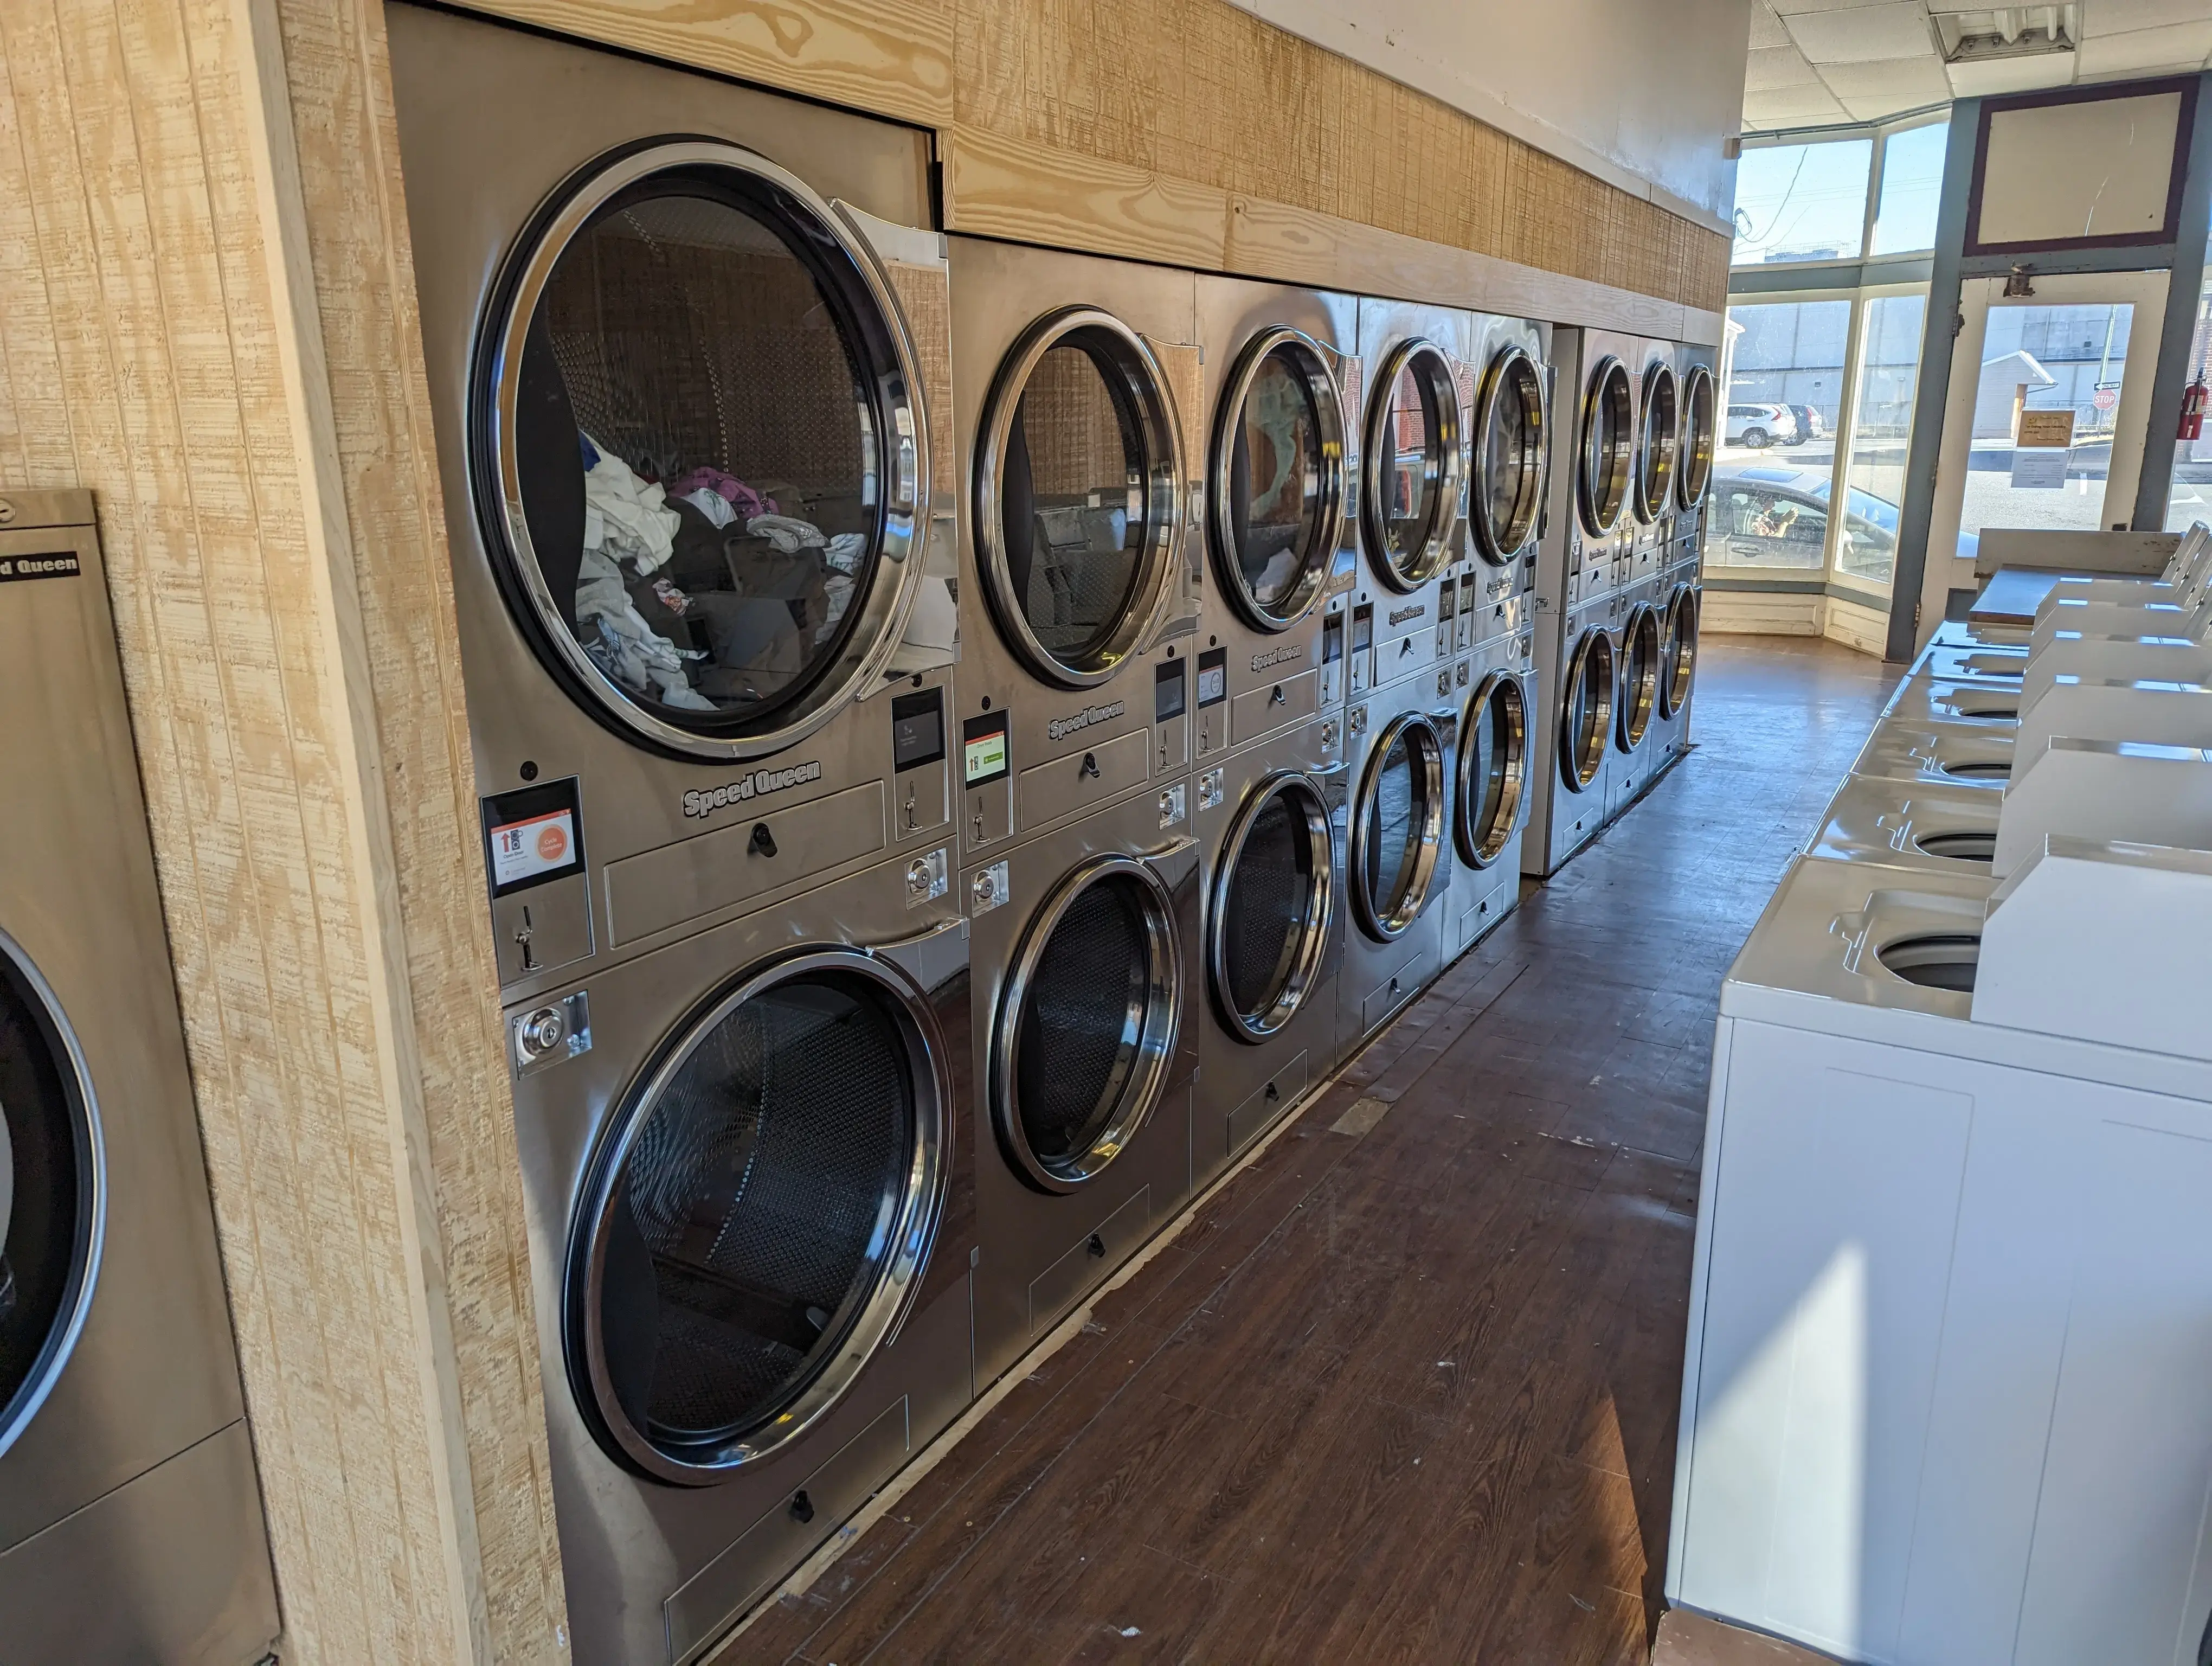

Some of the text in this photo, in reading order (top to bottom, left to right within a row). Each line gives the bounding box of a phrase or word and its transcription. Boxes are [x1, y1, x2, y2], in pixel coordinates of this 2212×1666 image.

[2094, 395, 2115, 403] STOP
[17, 559, 78, 573] Queen
[1251, 645, 1301, 672] Speed Queen
[1049, 701, 1124, 741] Speed Queen
[683, 760, 821, 819] Speed Queen
[541, 843, 562, 852] Complete
